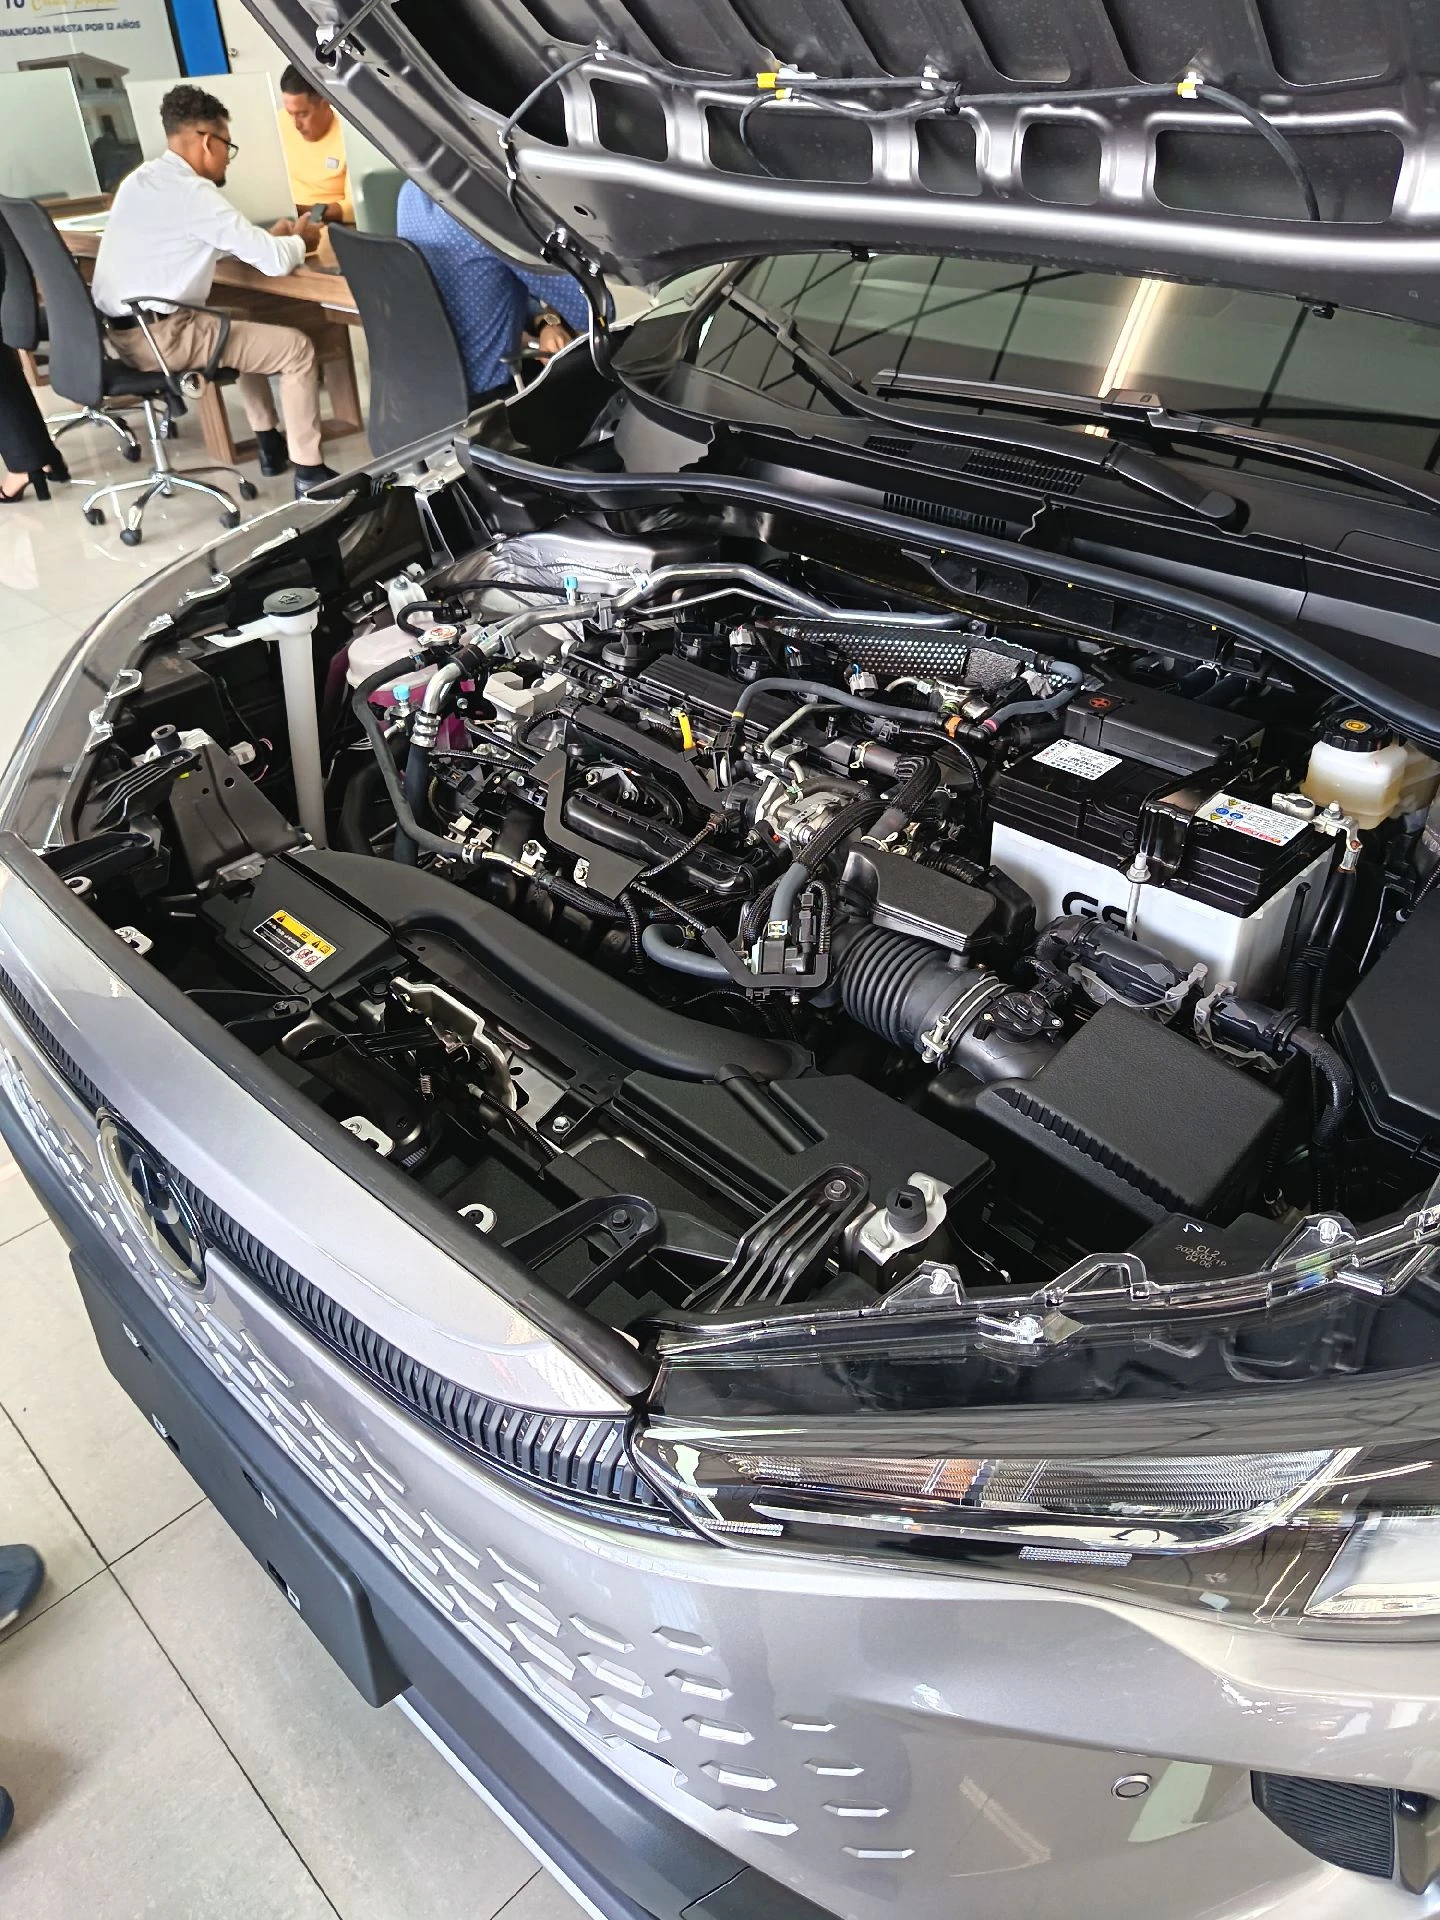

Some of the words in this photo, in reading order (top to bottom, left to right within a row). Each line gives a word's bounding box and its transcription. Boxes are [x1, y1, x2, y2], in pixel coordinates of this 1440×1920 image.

[0, 26, 52, 37] INANCIADA
[53, 22, 84, 34] HASTA
[84, 22, 105, 32] POR
[106, 22, 115, 31] 12
[116, 19, 141, 30] AÑOS
